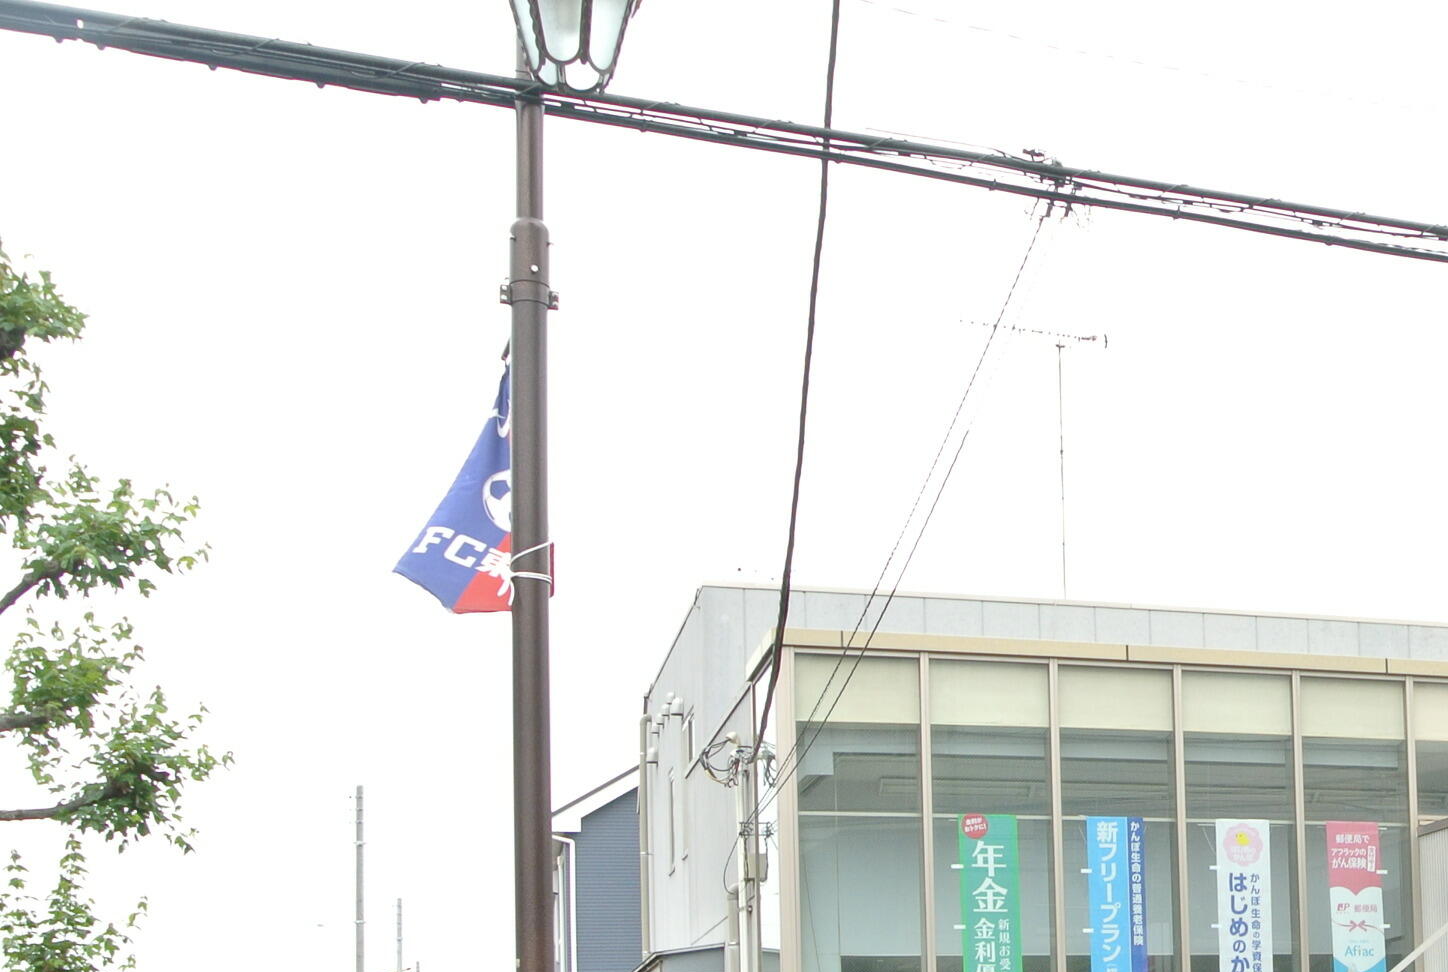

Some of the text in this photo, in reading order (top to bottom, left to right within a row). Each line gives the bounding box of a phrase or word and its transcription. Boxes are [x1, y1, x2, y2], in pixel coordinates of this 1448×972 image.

[1335, 834, 1370, 844] 郵便局で
[1331, 847, 1366, 856] アフラックの
[1331, 857, 1367, 869] がん保険
[971, 840, 1008, 913] 年金
[1096, 820, 1122, 962] 新フリープラン
